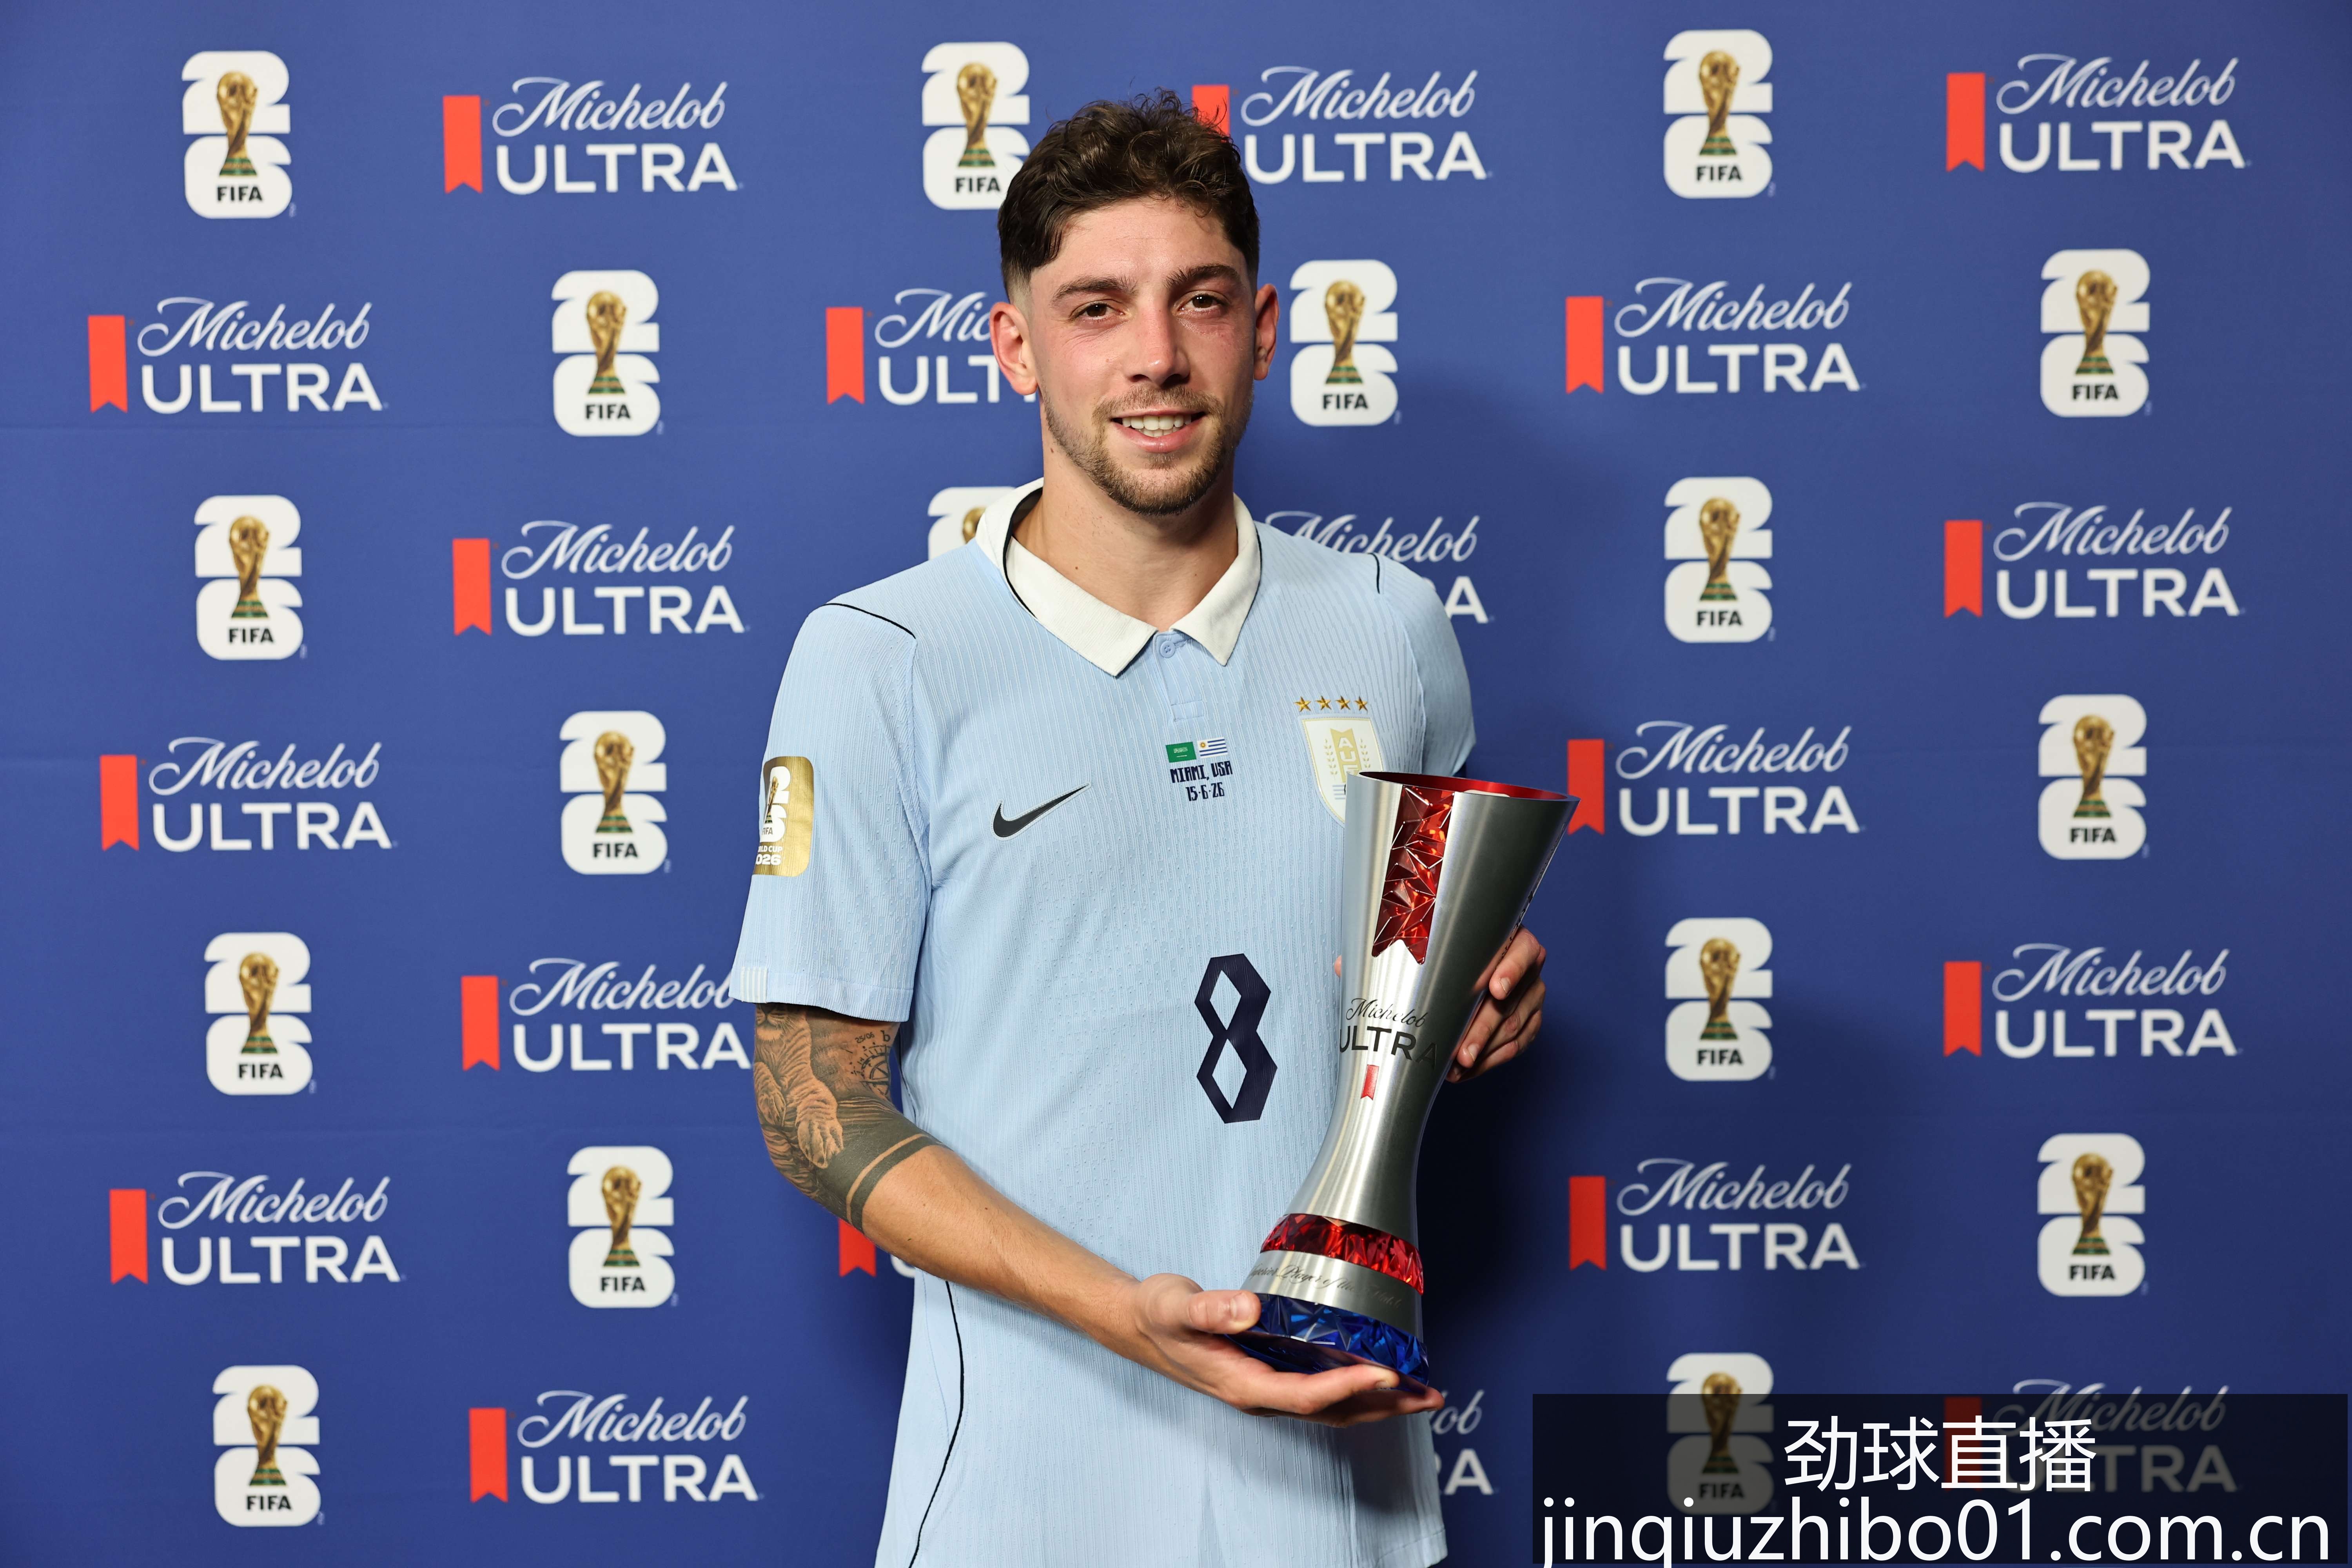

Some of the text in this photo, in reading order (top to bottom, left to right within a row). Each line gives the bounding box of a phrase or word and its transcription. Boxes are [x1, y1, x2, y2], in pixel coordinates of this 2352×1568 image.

[492, 77, 728, 137] Michelob
[1241, 66, 1477, 126] Michelob
[1996, 54, 2238, 114] Michelob
[497, 143, 738, 195] ULTRA
[1245, 131, 1487, 184] ULTRA
[2000, 120, 2245, 173] ULTRA
[217, 186, 263, 201] FIFA
[955, 177, 1000, 193] FIFA
[1696, 165, 1742, 181] FIFA
[138, 297, 372, 356] Michelob
[1614, 277, 1852, 338] Michelob
[142, 363, 383, 414] ULTRA
[878, 355, 1036, 405] ULT
[1618, 343, 1860, 395] ULTRA
[2072, 384, 2119, 400] FIFA
[585, 404, 631, 419] FIFA
[1323, 393, 1368, 410] FIFA
[501, 521, 734, 579] Michelob
[1993, 502, 2232, 561] Michelob
[505, 585, 745, 637] ULTRA
[1697, 610, 1742, 626] FIFA
[1997, 568, 2240, 619] ULTRA
[229, 628, 274, 643] FIFA
[149, 737, 381, 795] Michelob
[1170, 760, 1233, 783] MIAMI, USA
[1616, 721, 1851, 779] Michelob
[153, 802, 392, 852] ULTRA
[1619, 786, 1860, 836] ULTRA
[2070, 827, 2116, 843] FIFA
[593, 843, 638, 858] FIFA
[755, 853, 781, 866] 026
[1992, 943, 2229, 1002] Michelob
[1346, 998, 1428, 1027] Michelob
[1996, 1009, 2235, 1058] ULTRA
[514, 1022, 751, 1073] ULTRA
[1194, 953, 1278, 1124] 8
[1339, 1025, 1437, 1070] ULTRA
[1697, 1049, 1743, 1065] FIFA
[238, 1063, 283, 1079] FIFA
[158, 1171, 390, 1229] Michelob
[1617, 1158, 1851, 1216] Michelob
[162, 1236, 400, 1285] ULTRA
[1621, 1223, 1860, 1272] ULTRA
[2069, 1265, 2115, 1280] FIFA
[601, 1276, 645, 1292] FIFA
[517, 1390, 748, 1448] Michelob
[247, 1495, 292, 1510] FIFA
[521, 1454, 759, 1504] ULTRA
